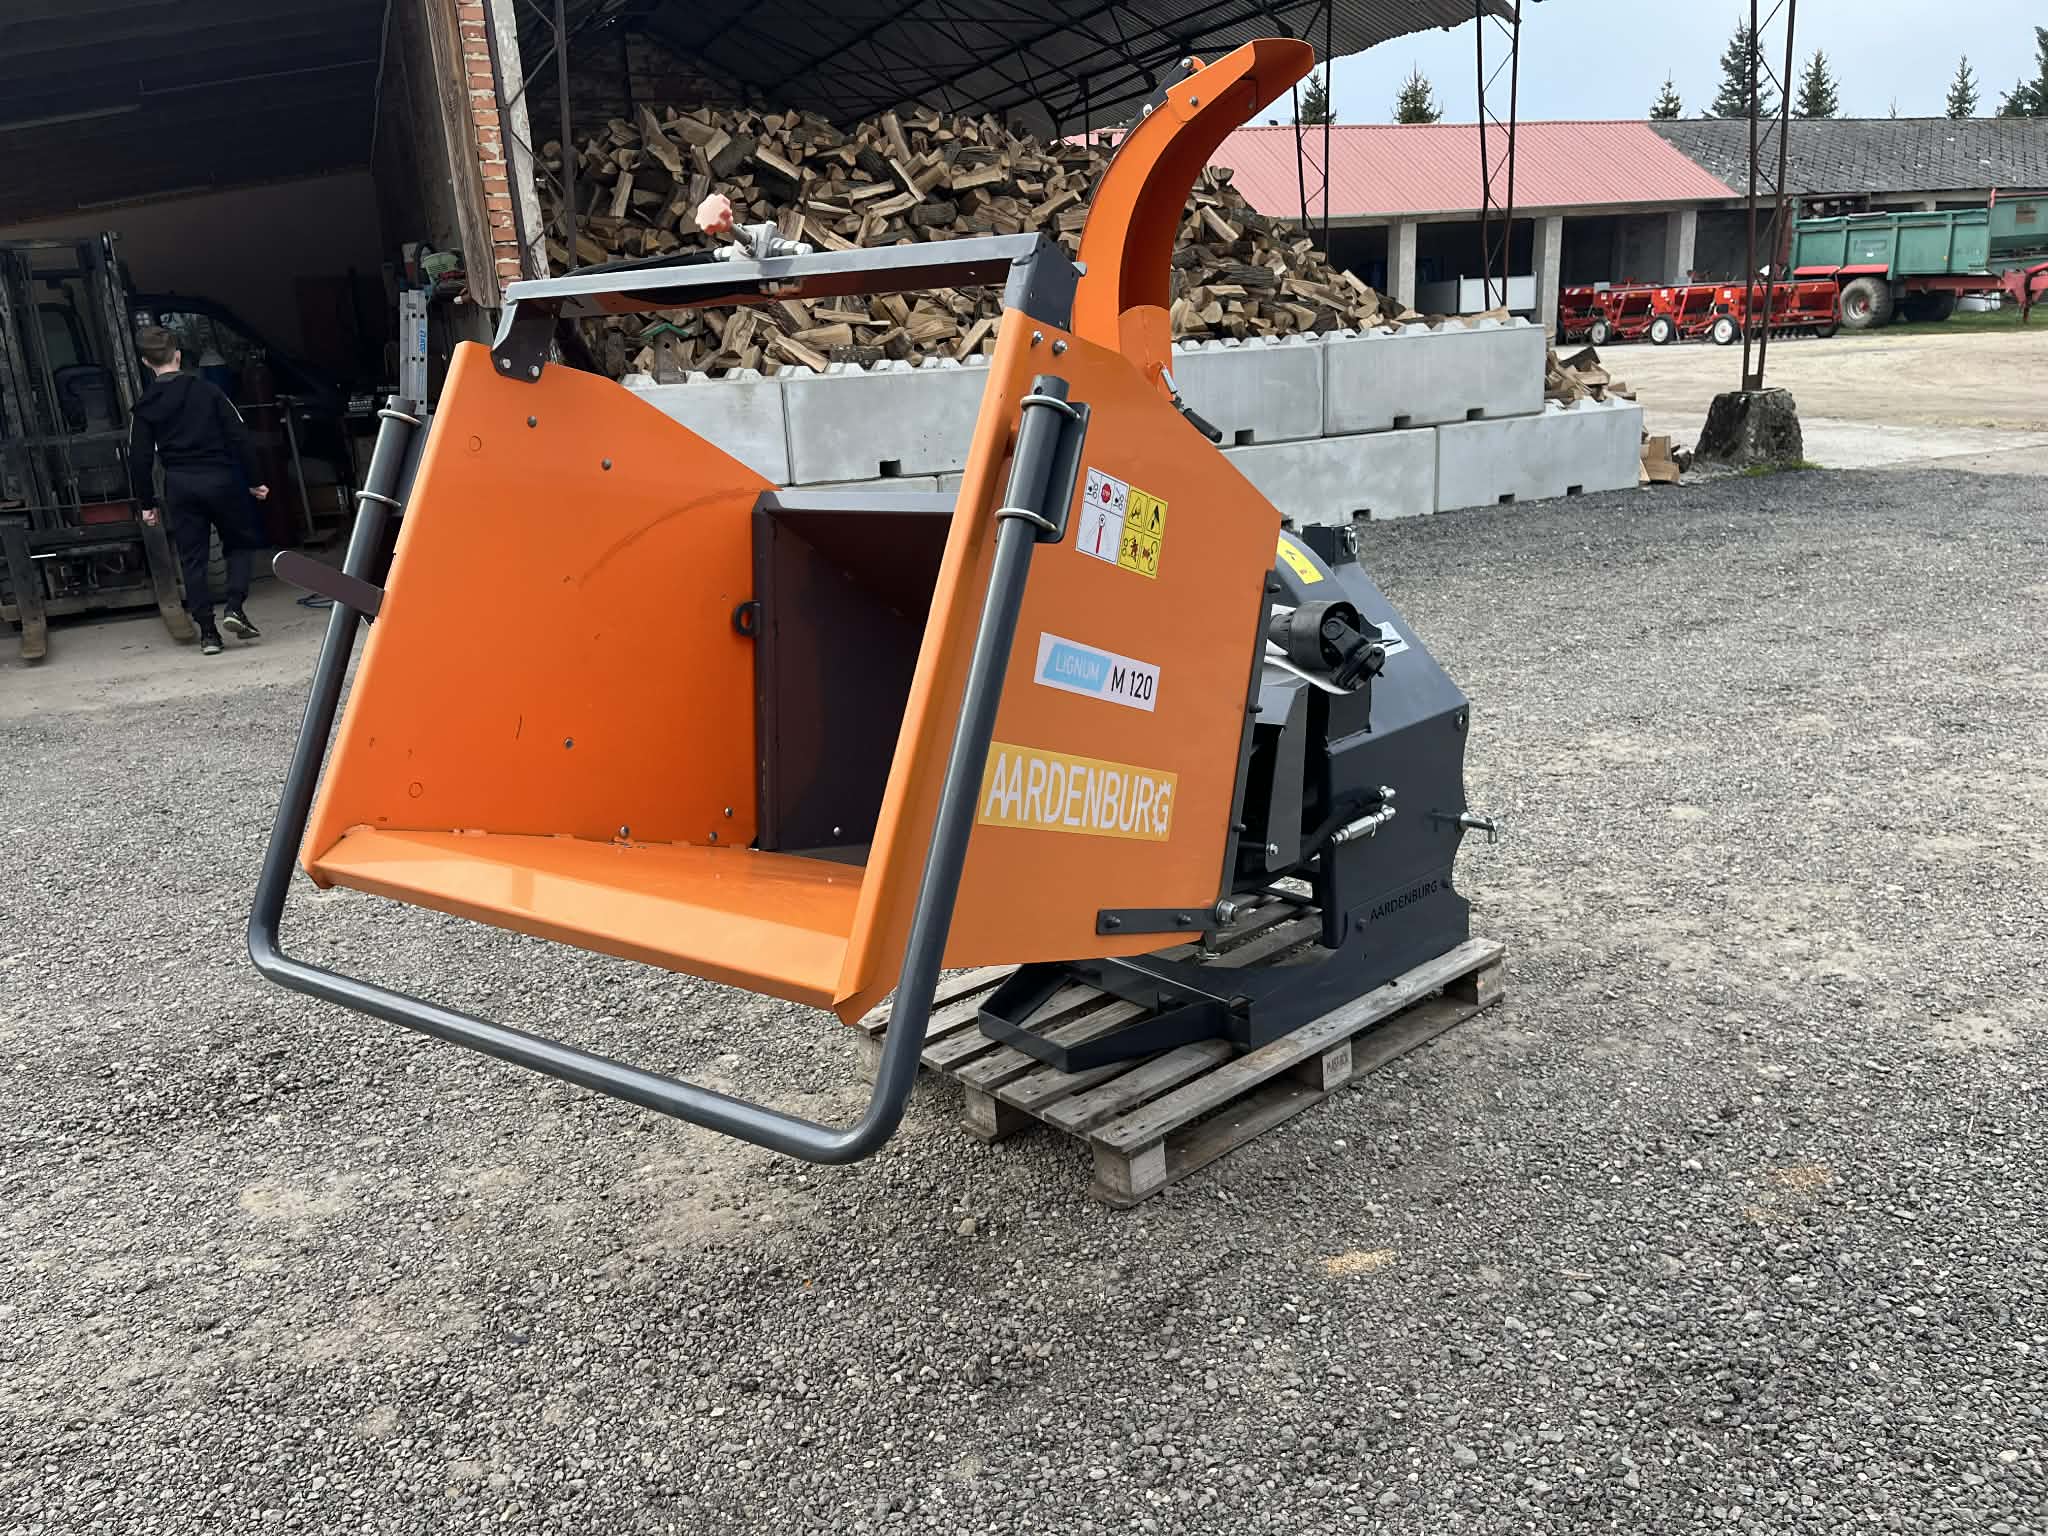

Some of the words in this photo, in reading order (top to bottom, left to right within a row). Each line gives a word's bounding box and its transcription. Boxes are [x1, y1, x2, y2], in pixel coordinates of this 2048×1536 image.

[1055, 650, 1101, 685] LIGNUM
[1111, 665, 1126, 693] M
[1130, 671, 1153, 700] 120
[984, 752, 1172, 835] AARDENBURG
[1369, 880, 1437, 921] AARDENBURG
